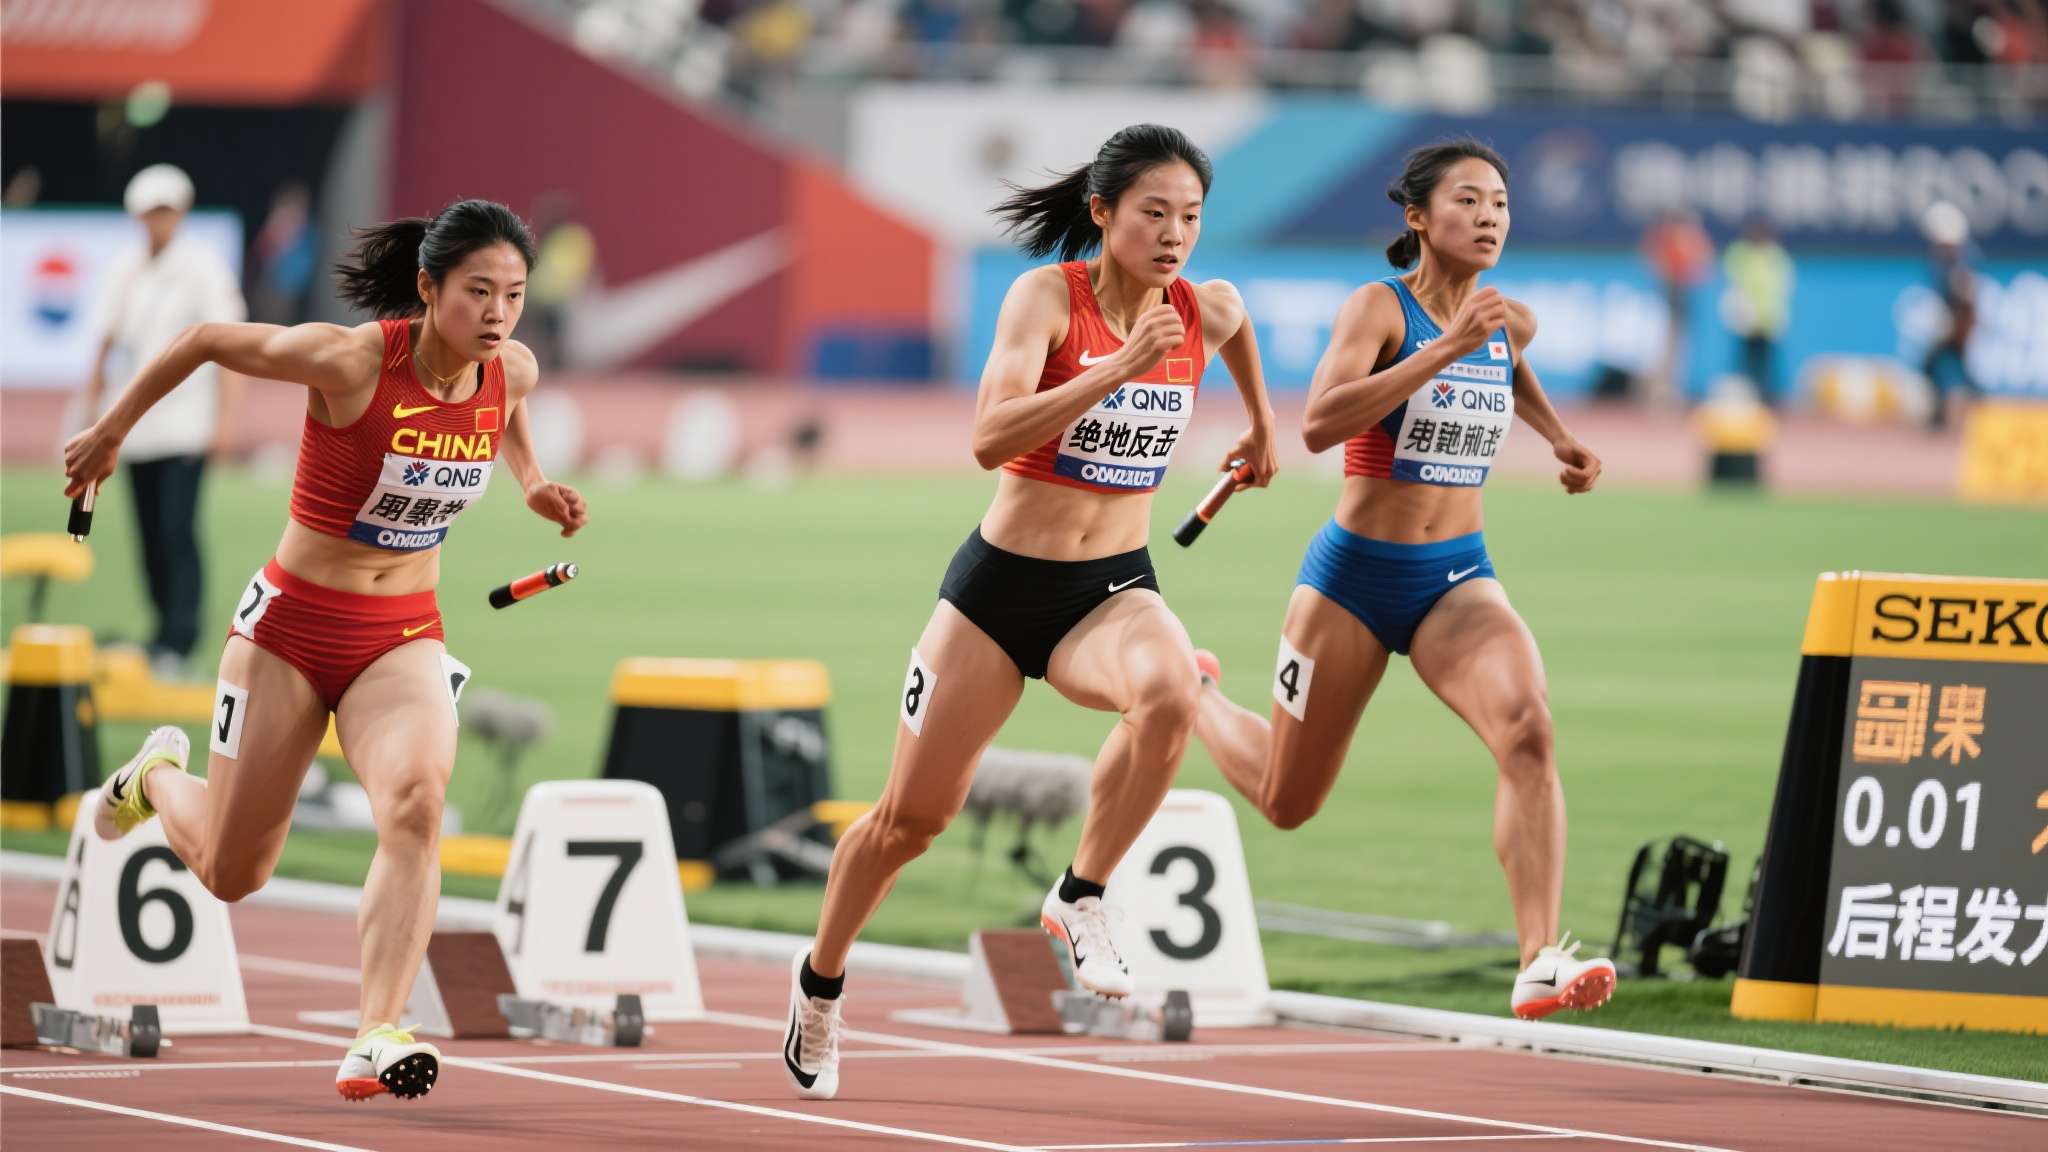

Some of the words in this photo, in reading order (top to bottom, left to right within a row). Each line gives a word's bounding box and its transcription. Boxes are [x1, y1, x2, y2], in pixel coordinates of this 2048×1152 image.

[1131, 388, 1182, 412] QNB
[1461, 389, 1506, 413] QNB
[391, 428, 493, 461] CHINA
[1068, 418, 1179, 459] 绝地反击
[434, 467, 482, 488] QNB
[1871, 593, 2048, 647] SEK
[1280, 659, 1300, 703] 4
[1843, 776, 1982, 851] 0.01
[117, 845, 194, 963] 6
[565, 840, 644, 953] 7
[1149, 845, 1222, 961] 3
